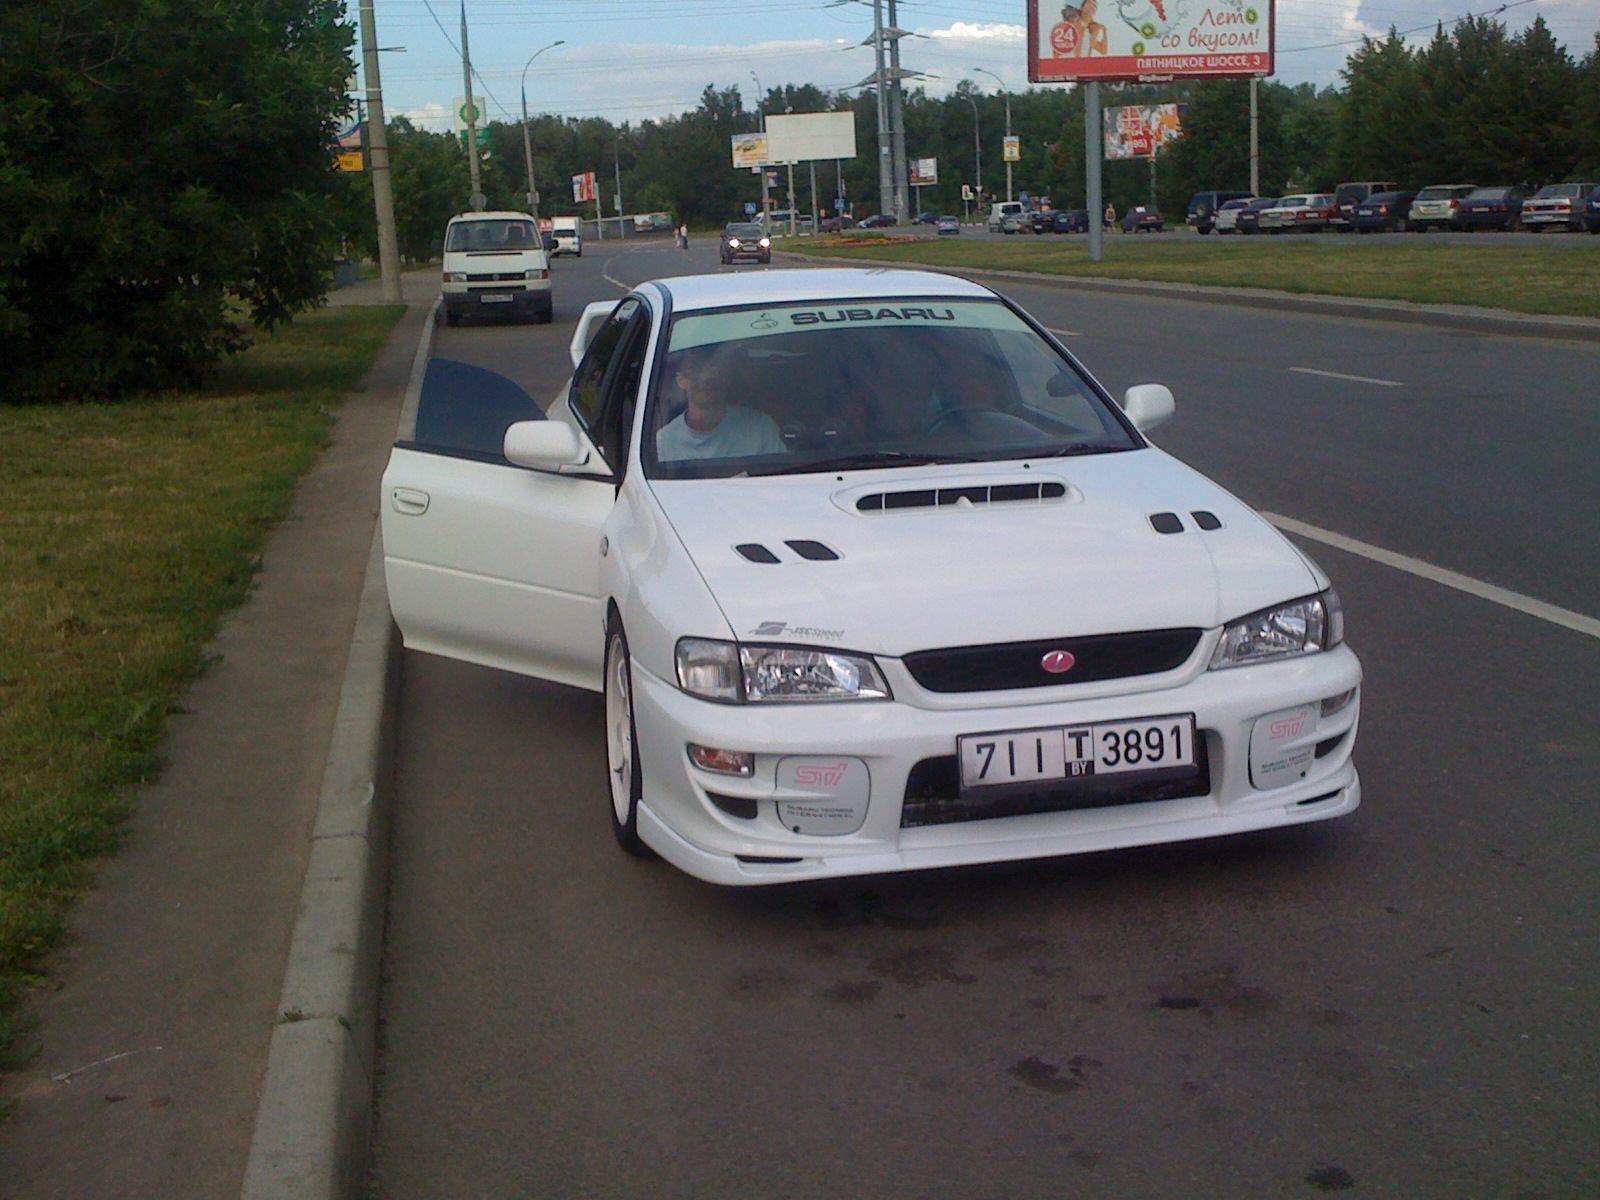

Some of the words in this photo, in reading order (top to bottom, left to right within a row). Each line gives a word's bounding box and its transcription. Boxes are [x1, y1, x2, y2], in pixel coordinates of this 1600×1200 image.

[1054, 28, 1074, 42] 24
[1161, 34, 1181, 48] со
[1136, 57, 1205, 69] ПЯТНИЦКОЕ
[1253, 54, 1261, 66] 3
[790, 308, 955, 325] SUBARU
[1068, 730, 1089, 759] T
[1102, 725, 1182, 766] 3891
[1071, 762, 1087, 776] BY
